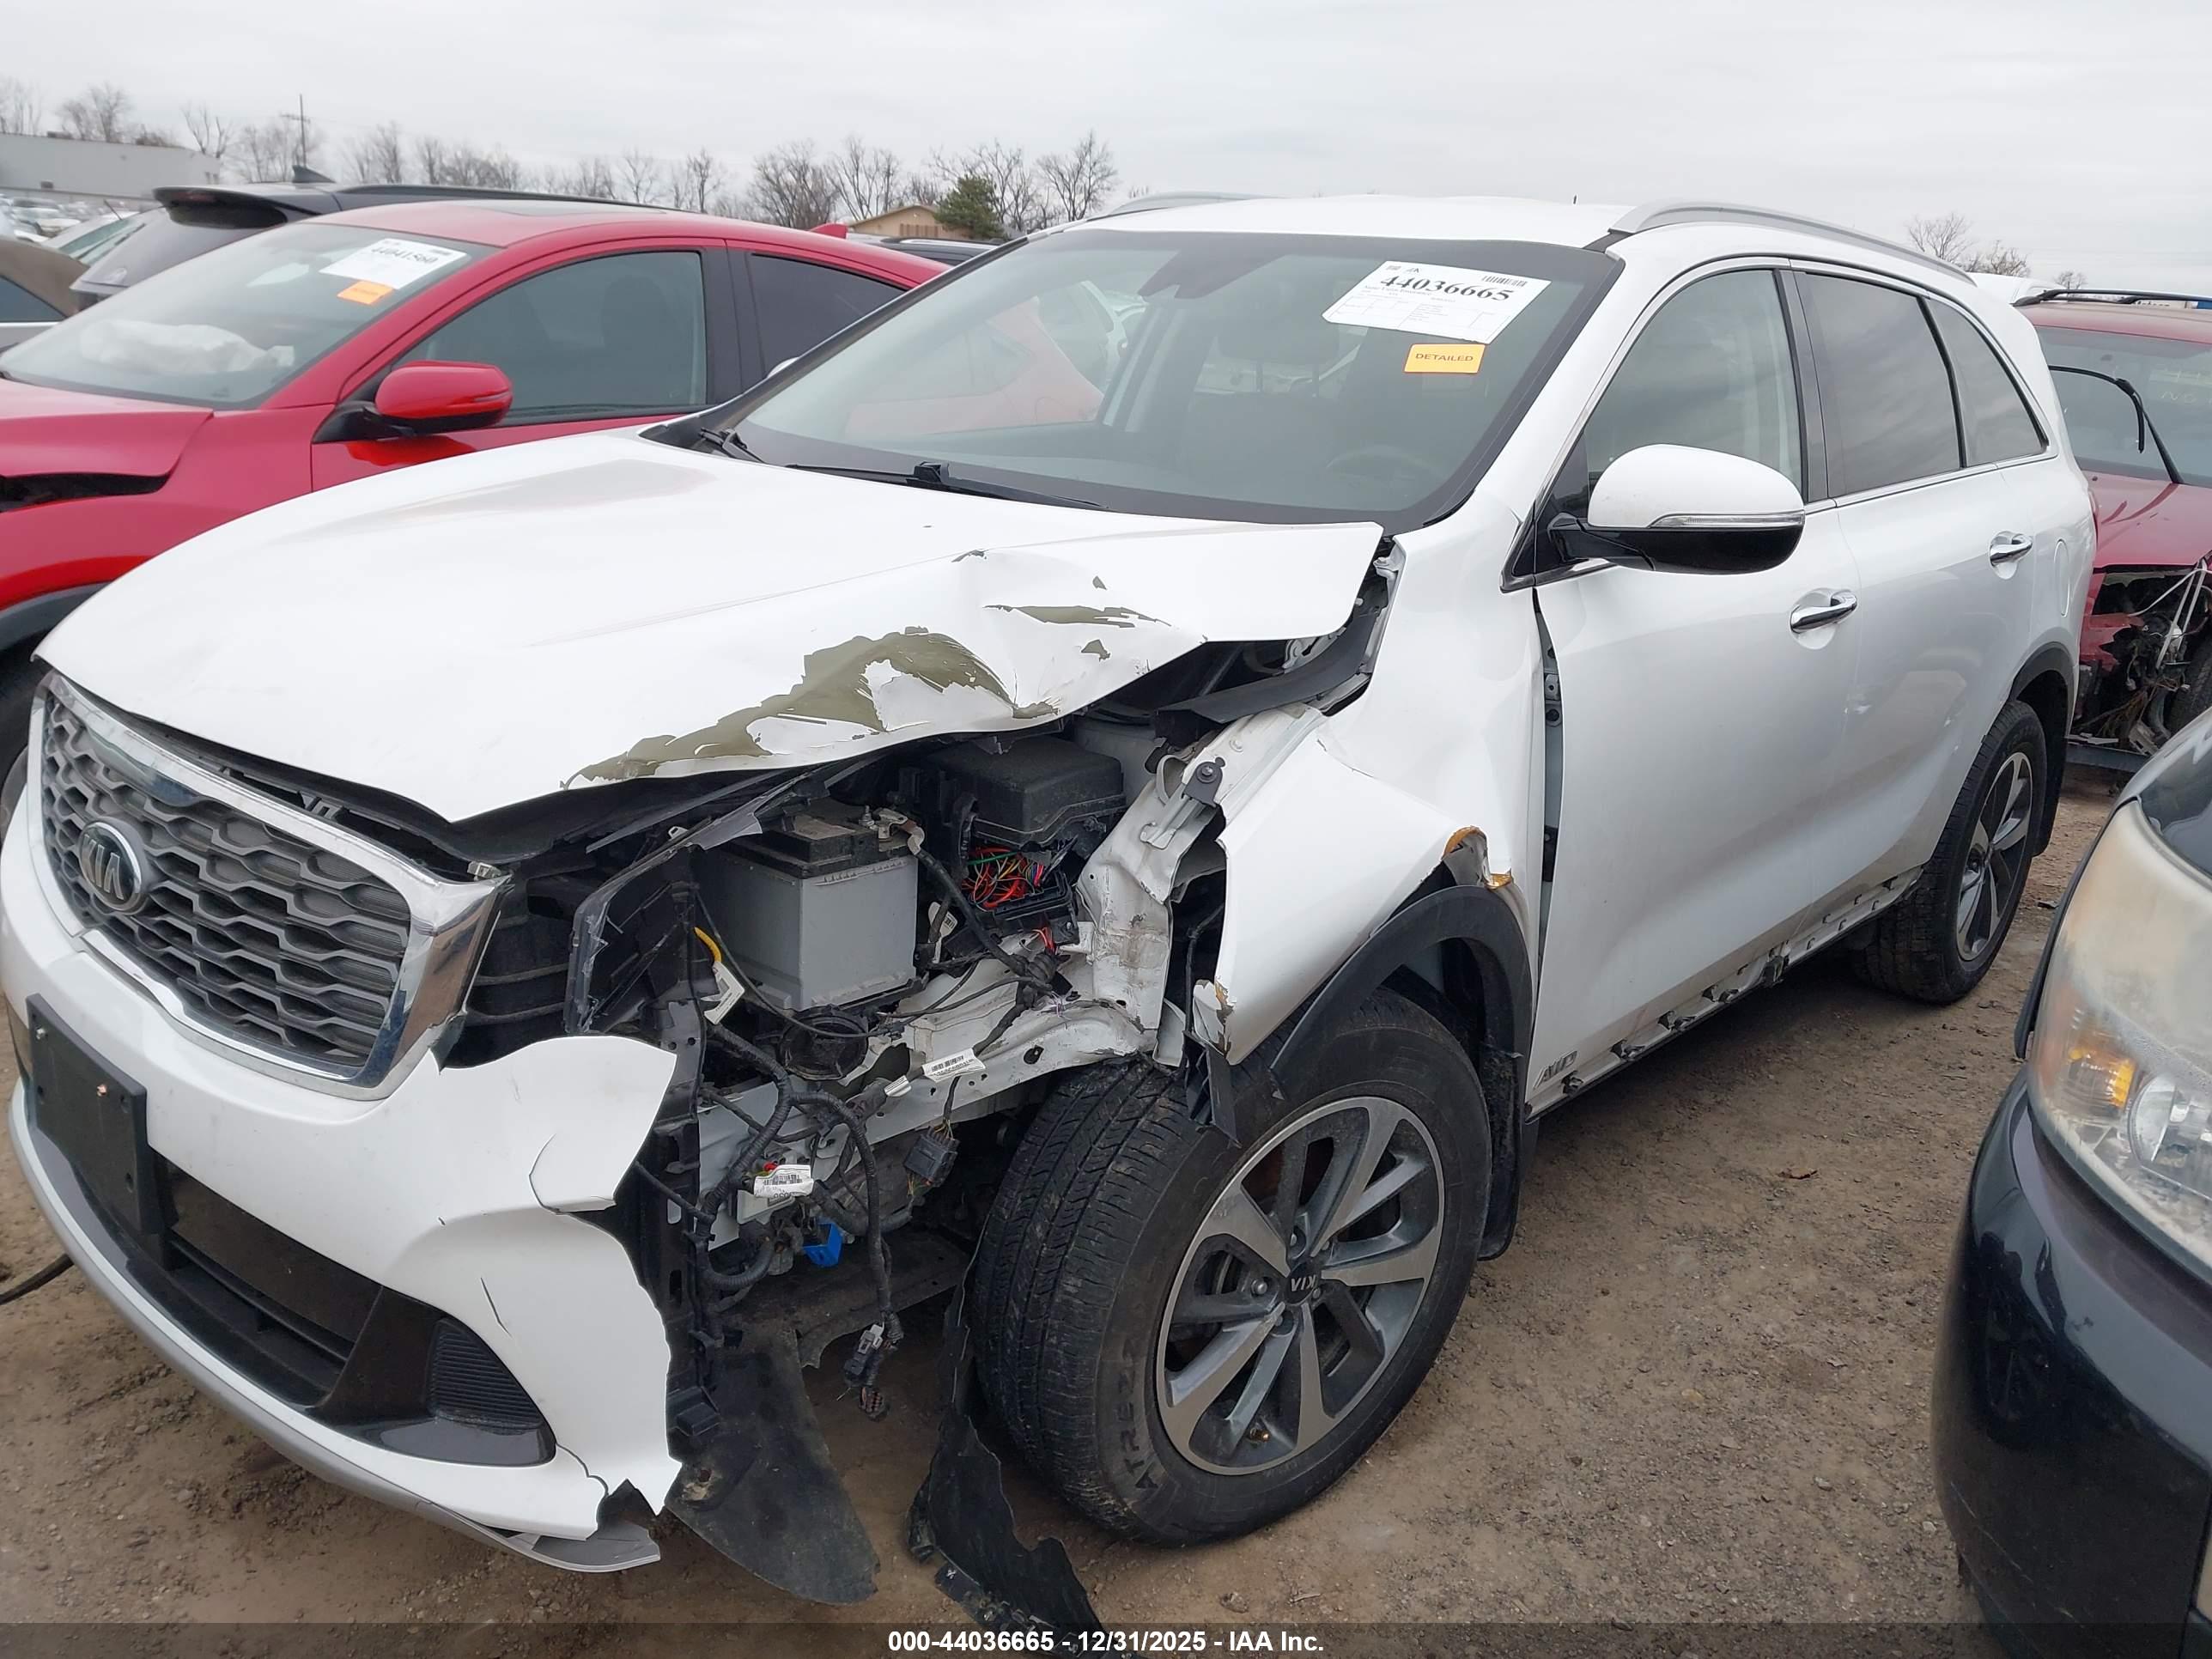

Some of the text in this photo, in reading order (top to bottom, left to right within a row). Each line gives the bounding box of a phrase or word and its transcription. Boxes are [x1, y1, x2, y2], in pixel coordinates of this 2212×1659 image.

[1380, 275, 1515, 302] 44036665
[1415, 351, 1474, 363] DETAILED
[82, 833, 125, 901] KIA
[1291, 1273, 1317, 1292] KIA
